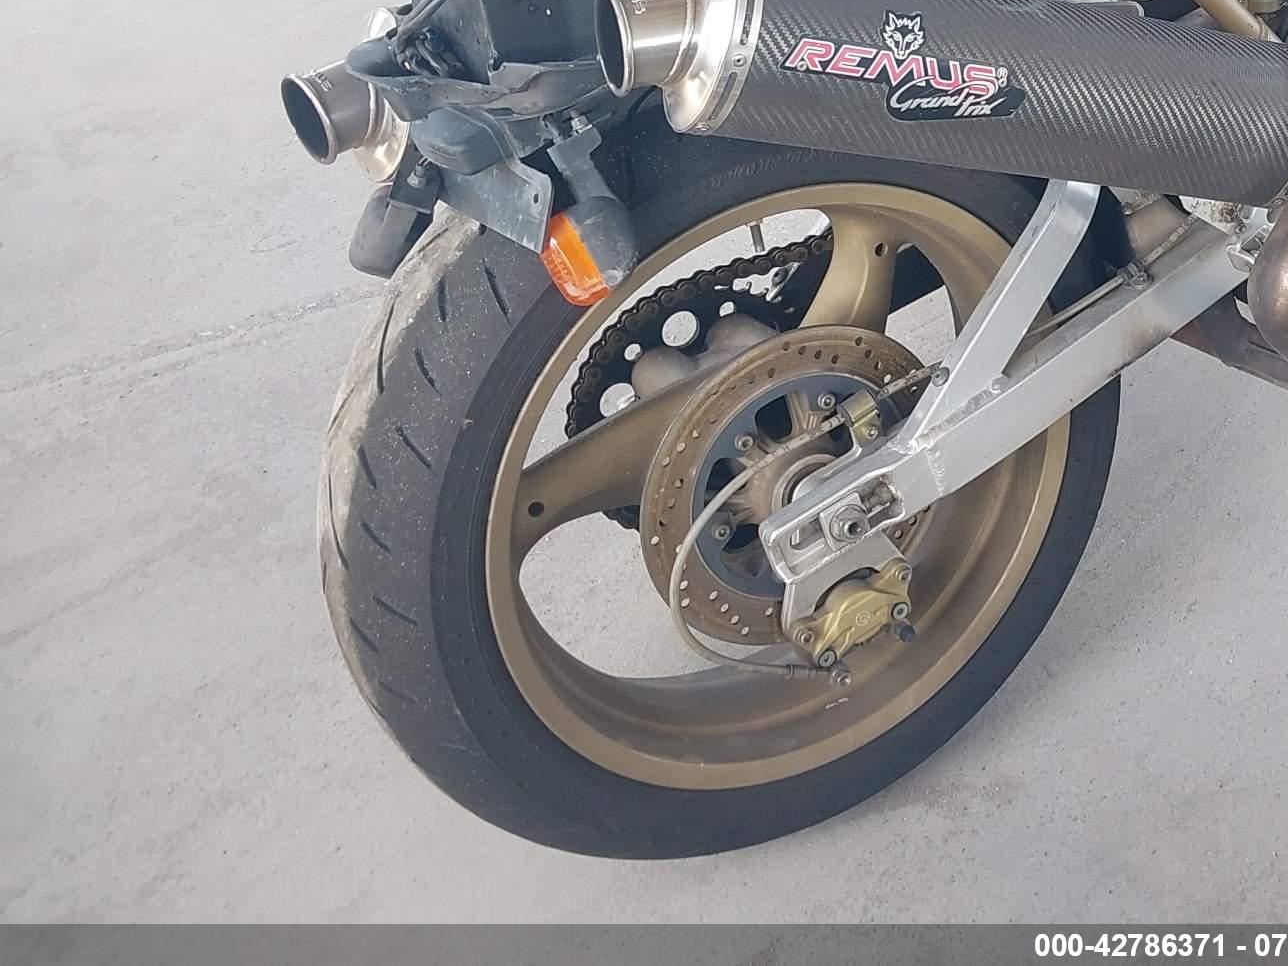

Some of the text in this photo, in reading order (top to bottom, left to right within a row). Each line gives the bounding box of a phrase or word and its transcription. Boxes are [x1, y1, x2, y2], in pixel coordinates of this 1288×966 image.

[785, 37, 997, 96] REMUS
[890, 75, 1007, 117] Grand Prix
